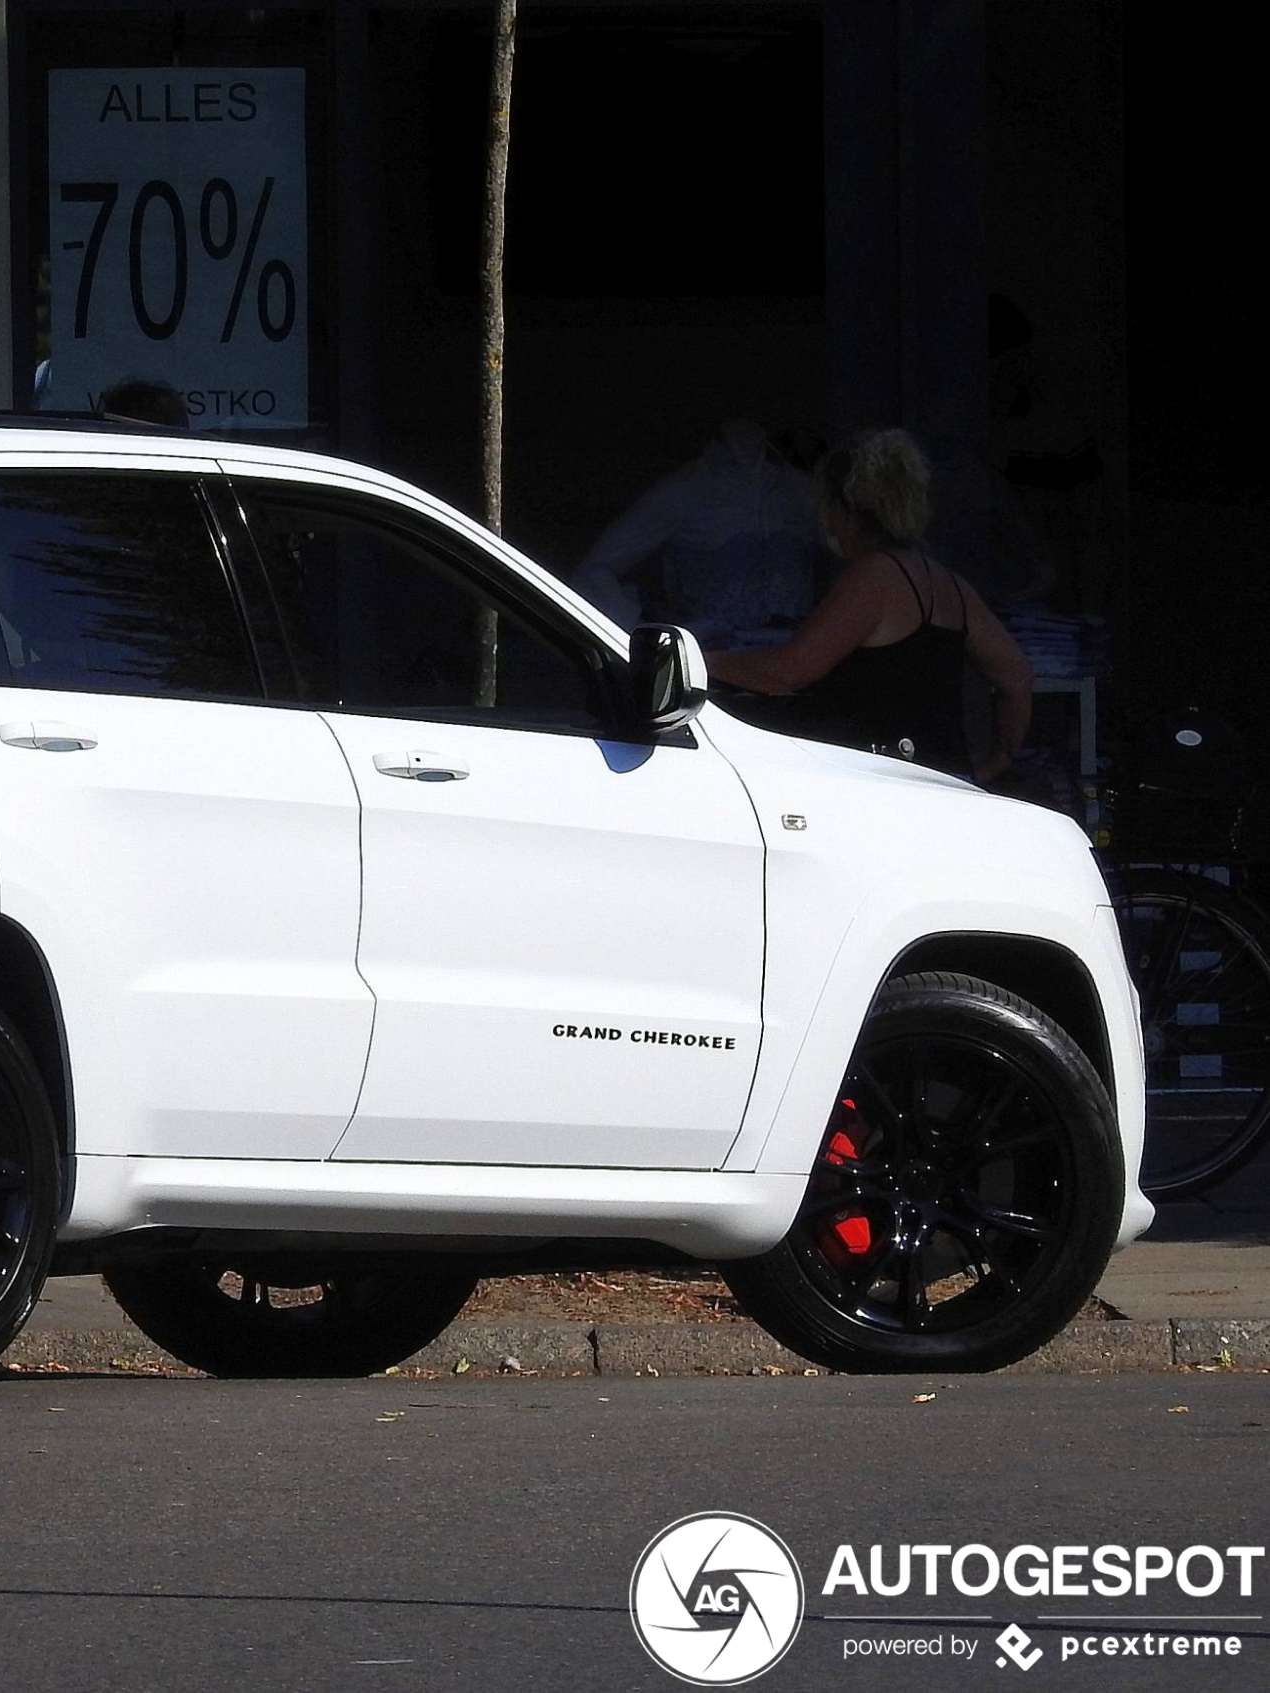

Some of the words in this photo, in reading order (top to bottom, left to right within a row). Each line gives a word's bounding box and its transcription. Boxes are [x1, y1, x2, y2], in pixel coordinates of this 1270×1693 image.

[100, 83, 257, 122] ALLES
[552, 1024, 622, 1041] GRAND
[630, 1030, 736, 1050] CHEROKEE
